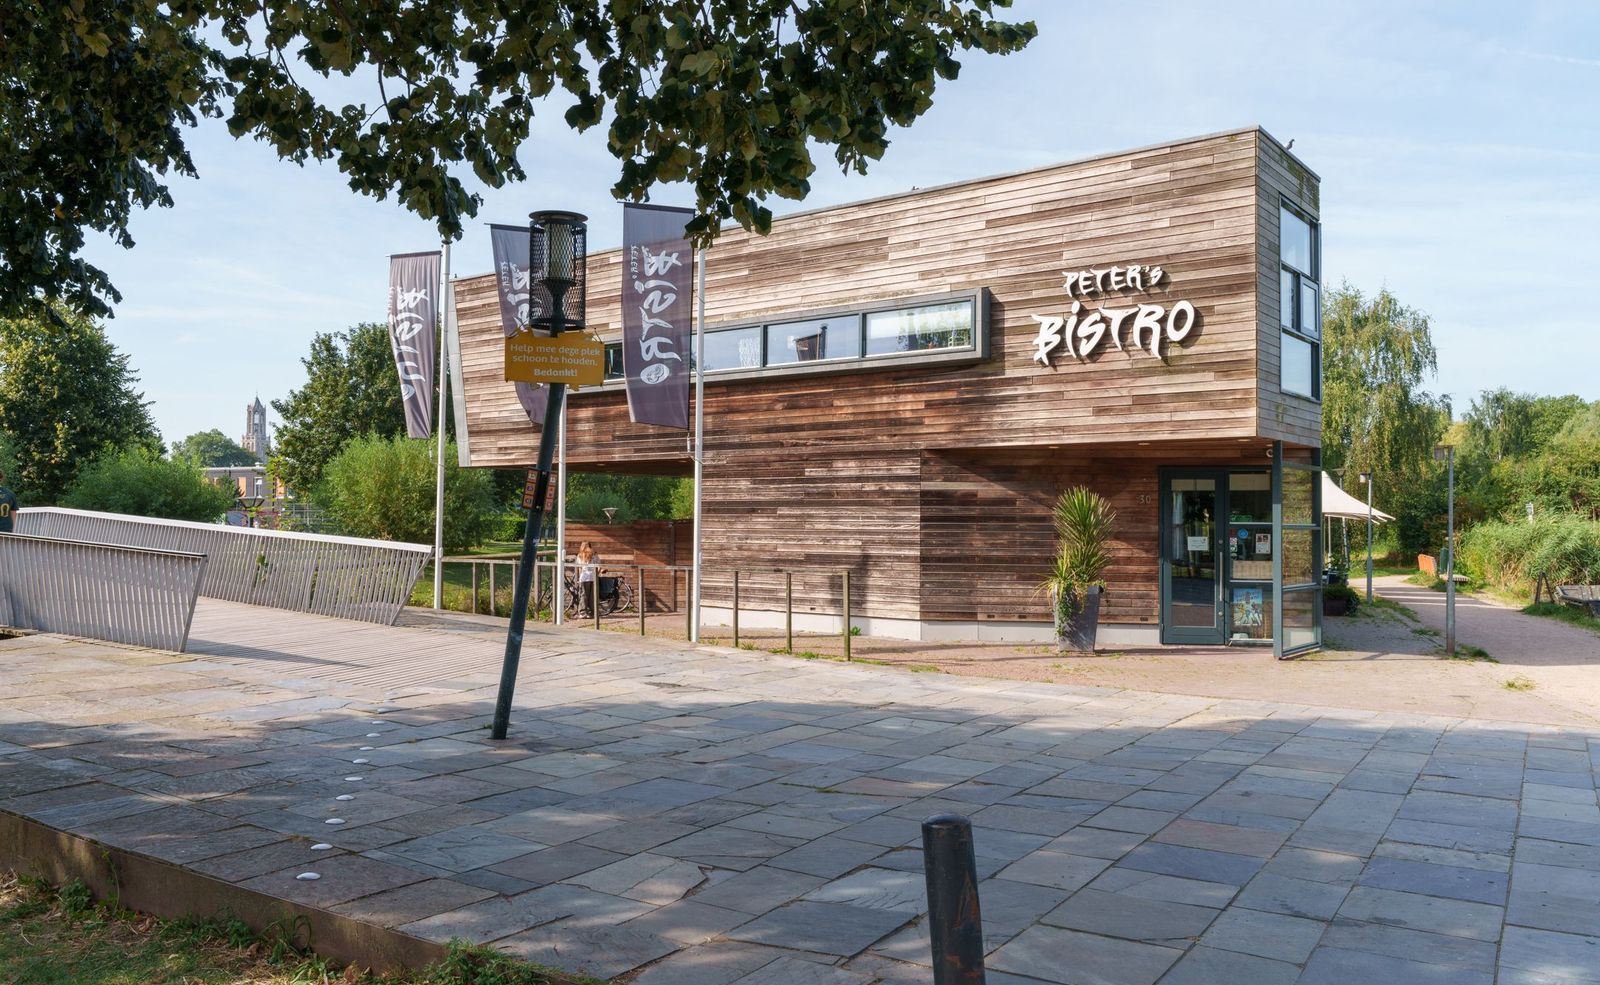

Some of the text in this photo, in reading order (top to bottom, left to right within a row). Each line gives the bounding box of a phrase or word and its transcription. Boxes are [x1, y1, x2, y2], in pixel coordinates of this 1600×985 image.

[510, 344, 534, 353] Help
[558, 345, 579, 355] deze
[580, 347, 600, 356] plek
[512, 354, 598, 366] schoon te houden.
[534, 368, 577, 377] Bedankt!
